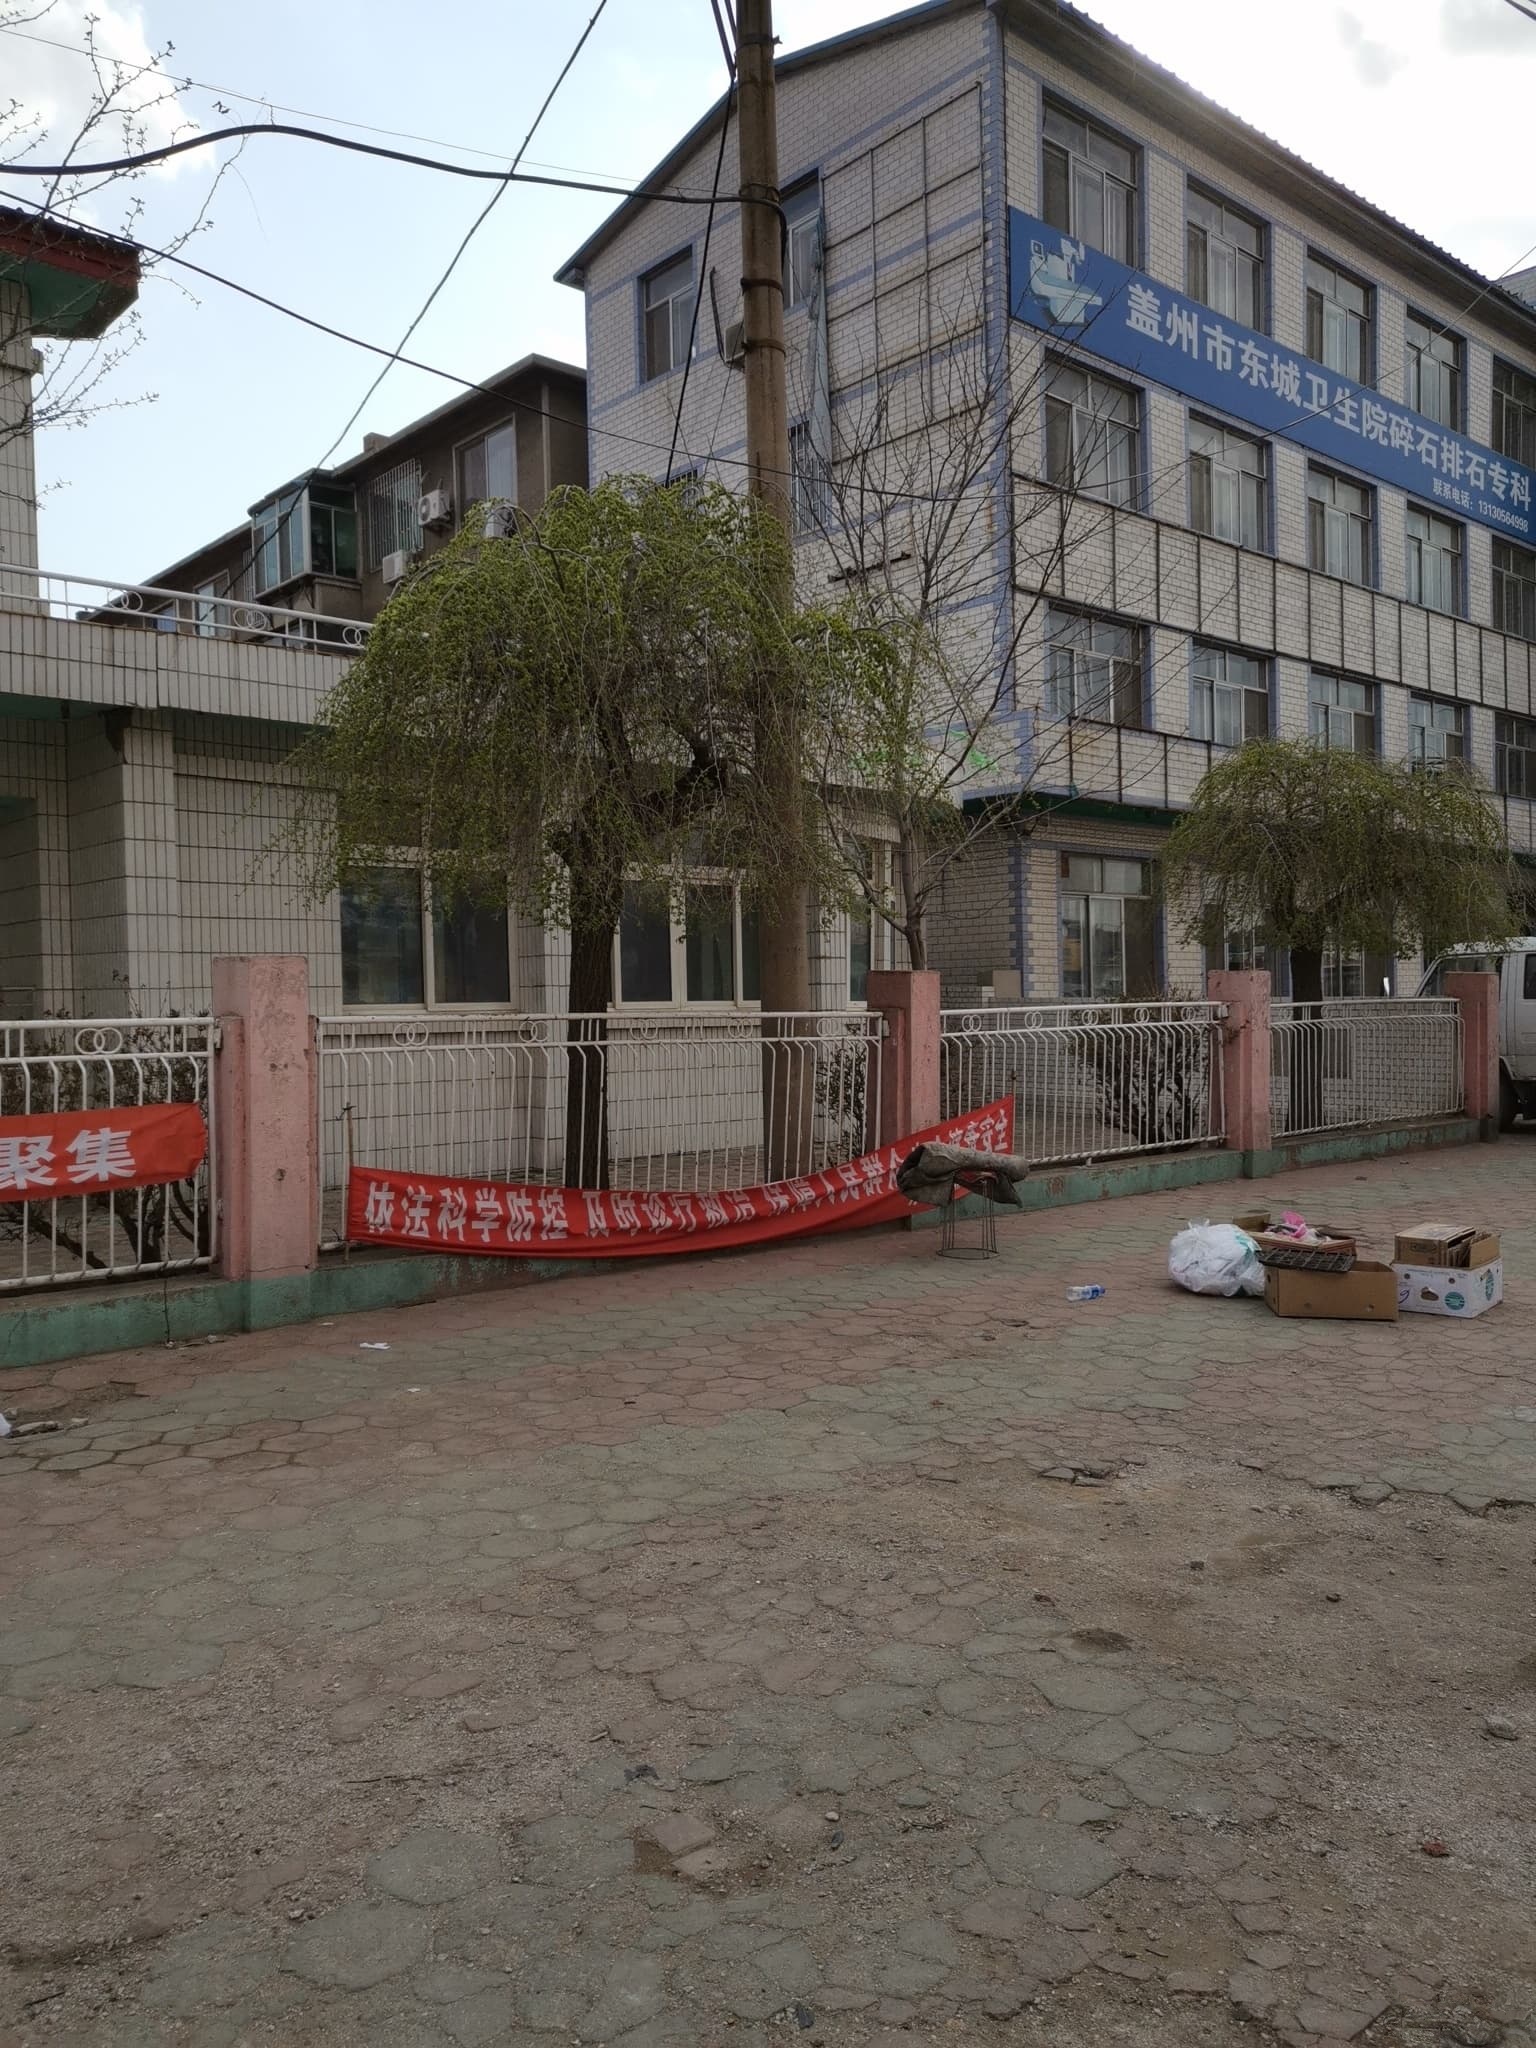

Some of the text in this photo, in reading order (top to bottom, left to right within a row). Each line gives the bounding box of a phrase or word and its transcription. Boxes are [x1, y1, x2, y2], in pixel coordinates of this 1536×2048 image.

[1126, 284, 1531, 512] 盖州市东城卫生院碎石排石专科
[0, 1127, 136, 1190] 聚集
[365, 1181, 569, 1242] 依法科学防控
